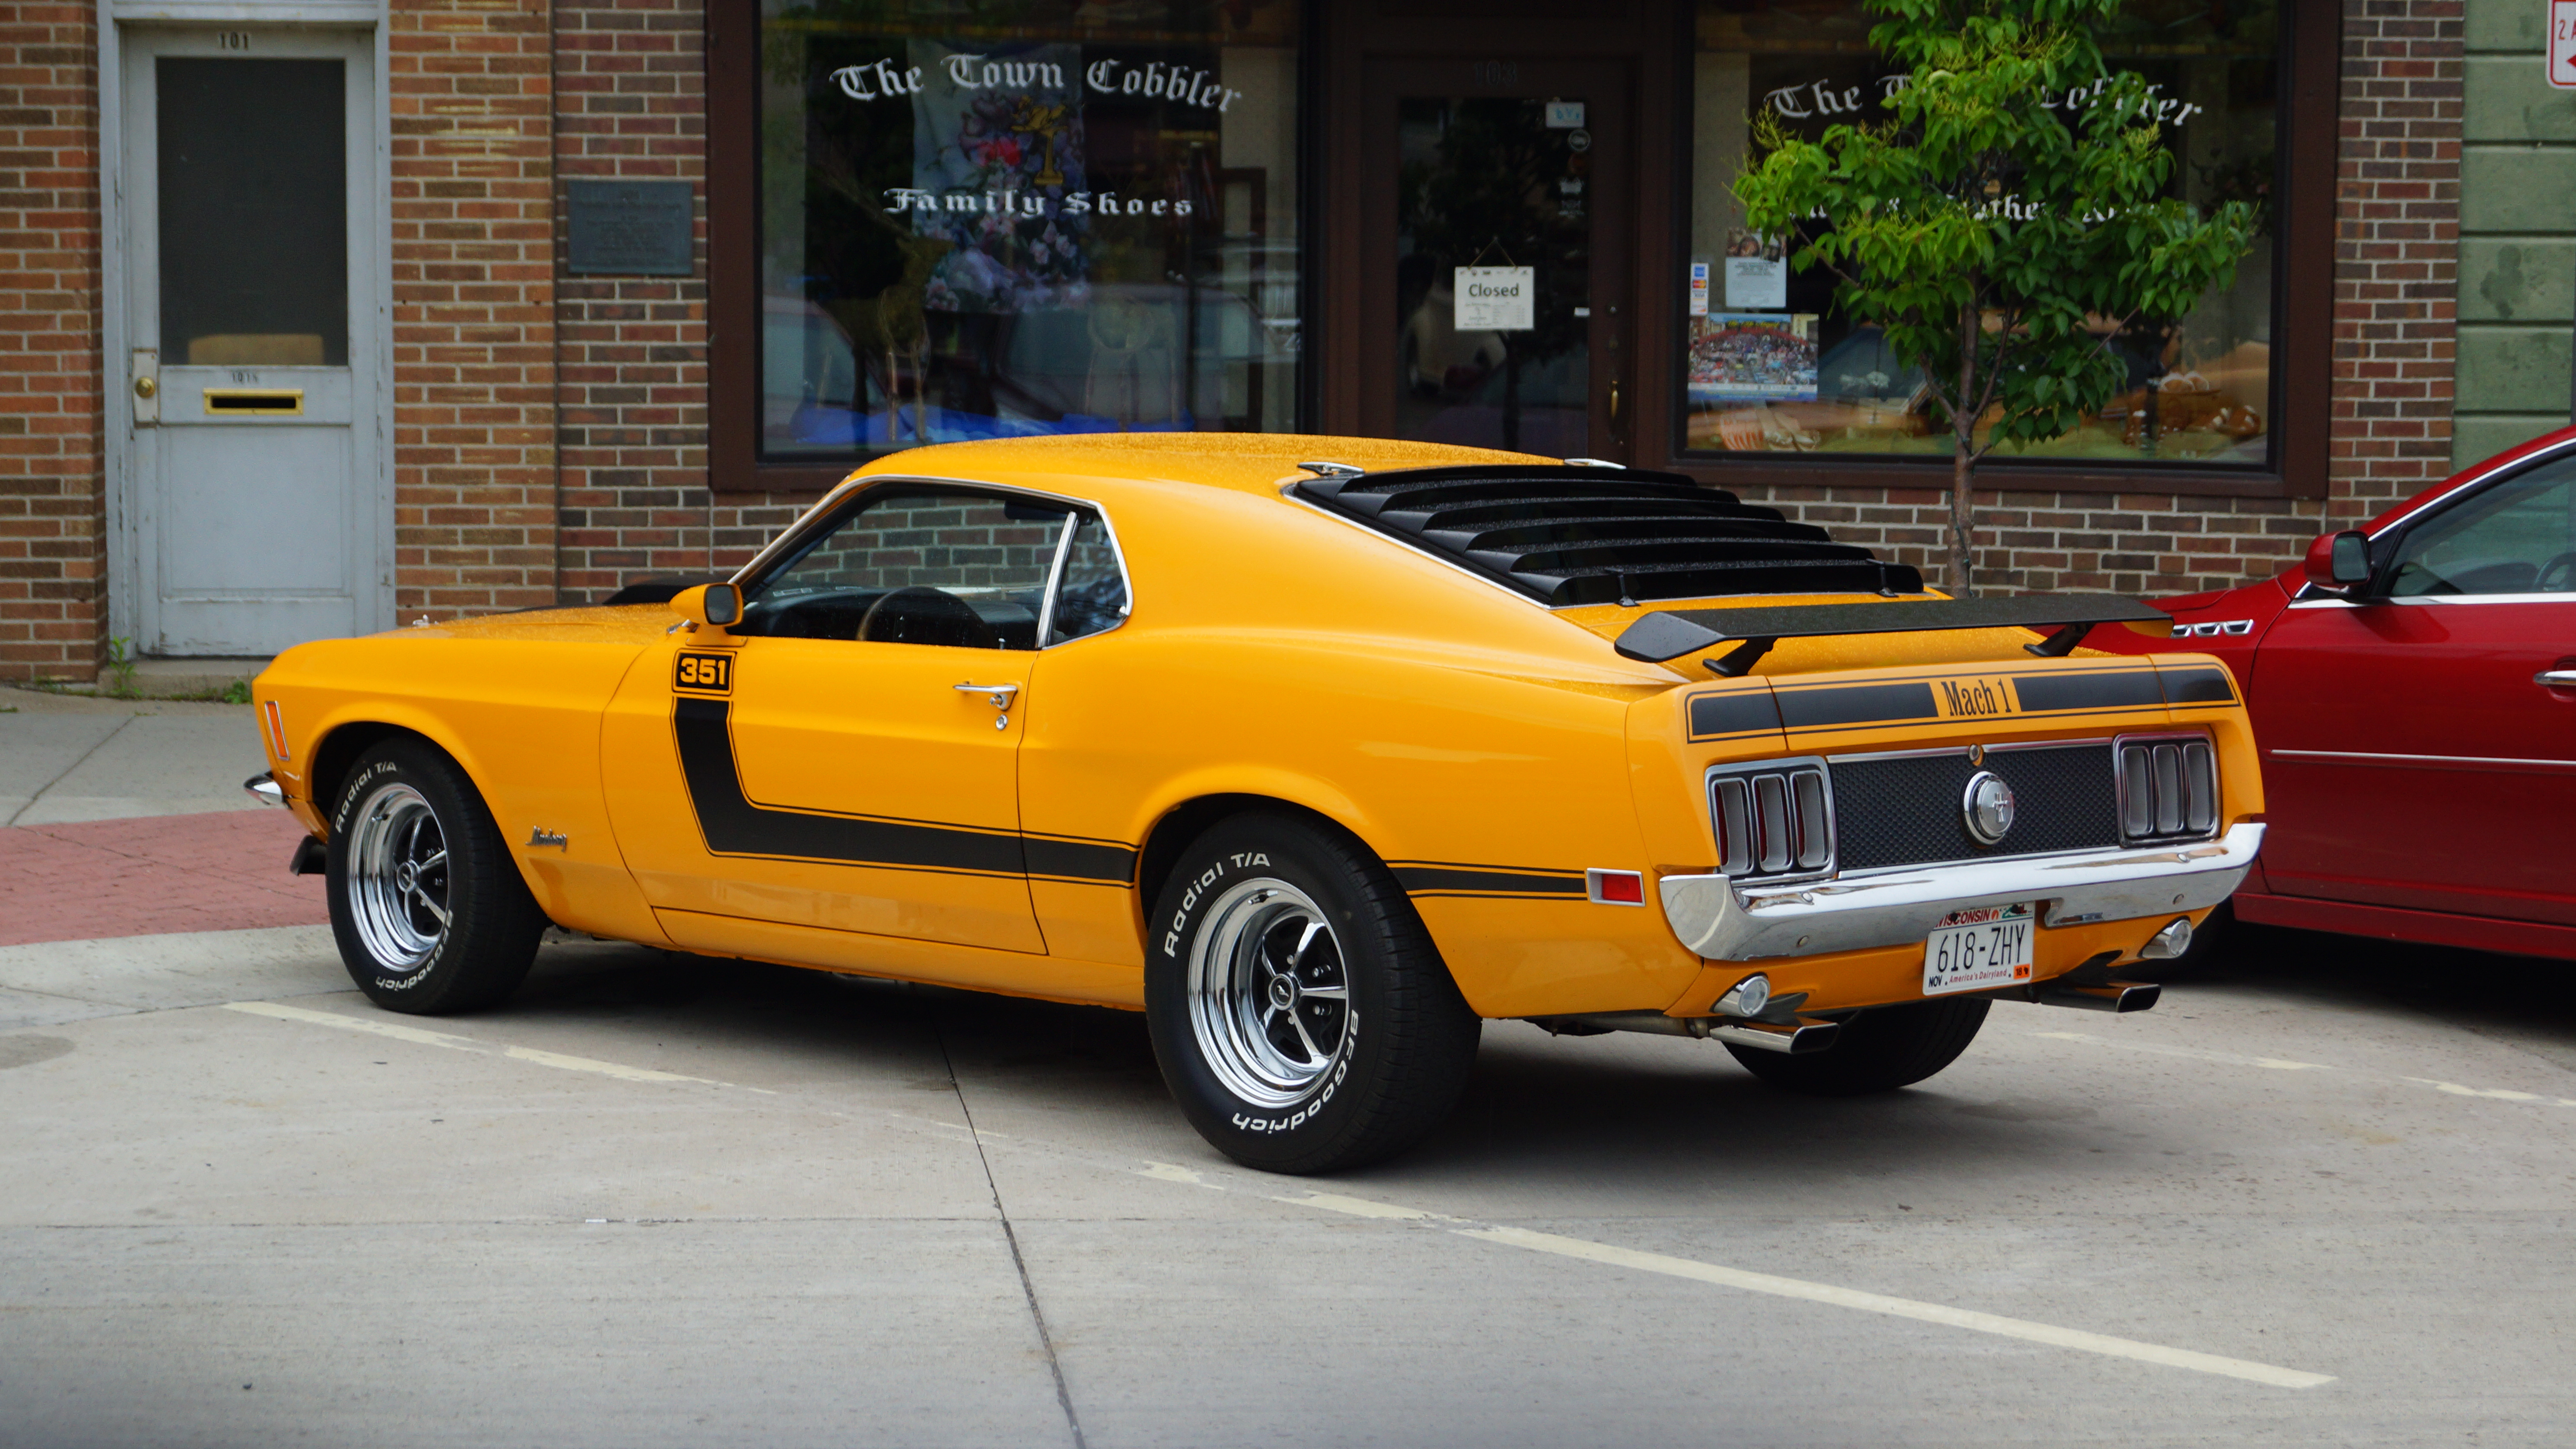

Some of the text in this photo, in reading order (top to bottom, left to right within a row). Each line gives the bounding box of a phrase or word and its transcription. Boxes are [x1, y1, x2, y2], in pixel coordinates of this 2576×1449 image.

[219, 32, 249, 50] 101
[2558, 19, 2566, 40] 2
[829, 52, 1242, 112] The Town Cobbler
[1763, 78, 1863, 119] The
[883, 187, 1193, 219] Family Shoes
[1469, 282, 1519, 297] Closed
[680, 657, 726, 685] 351
[1941, 678, 2011, 716] Mach 1
[335, 761, 397, 834] Radial T/A
[1164, 852, 1270, 958] Radial T/A
[1937, 923, 2026, 973] 618-ZHY
[1928, 967, 2022, 988] NOV America's Dairyland 18
